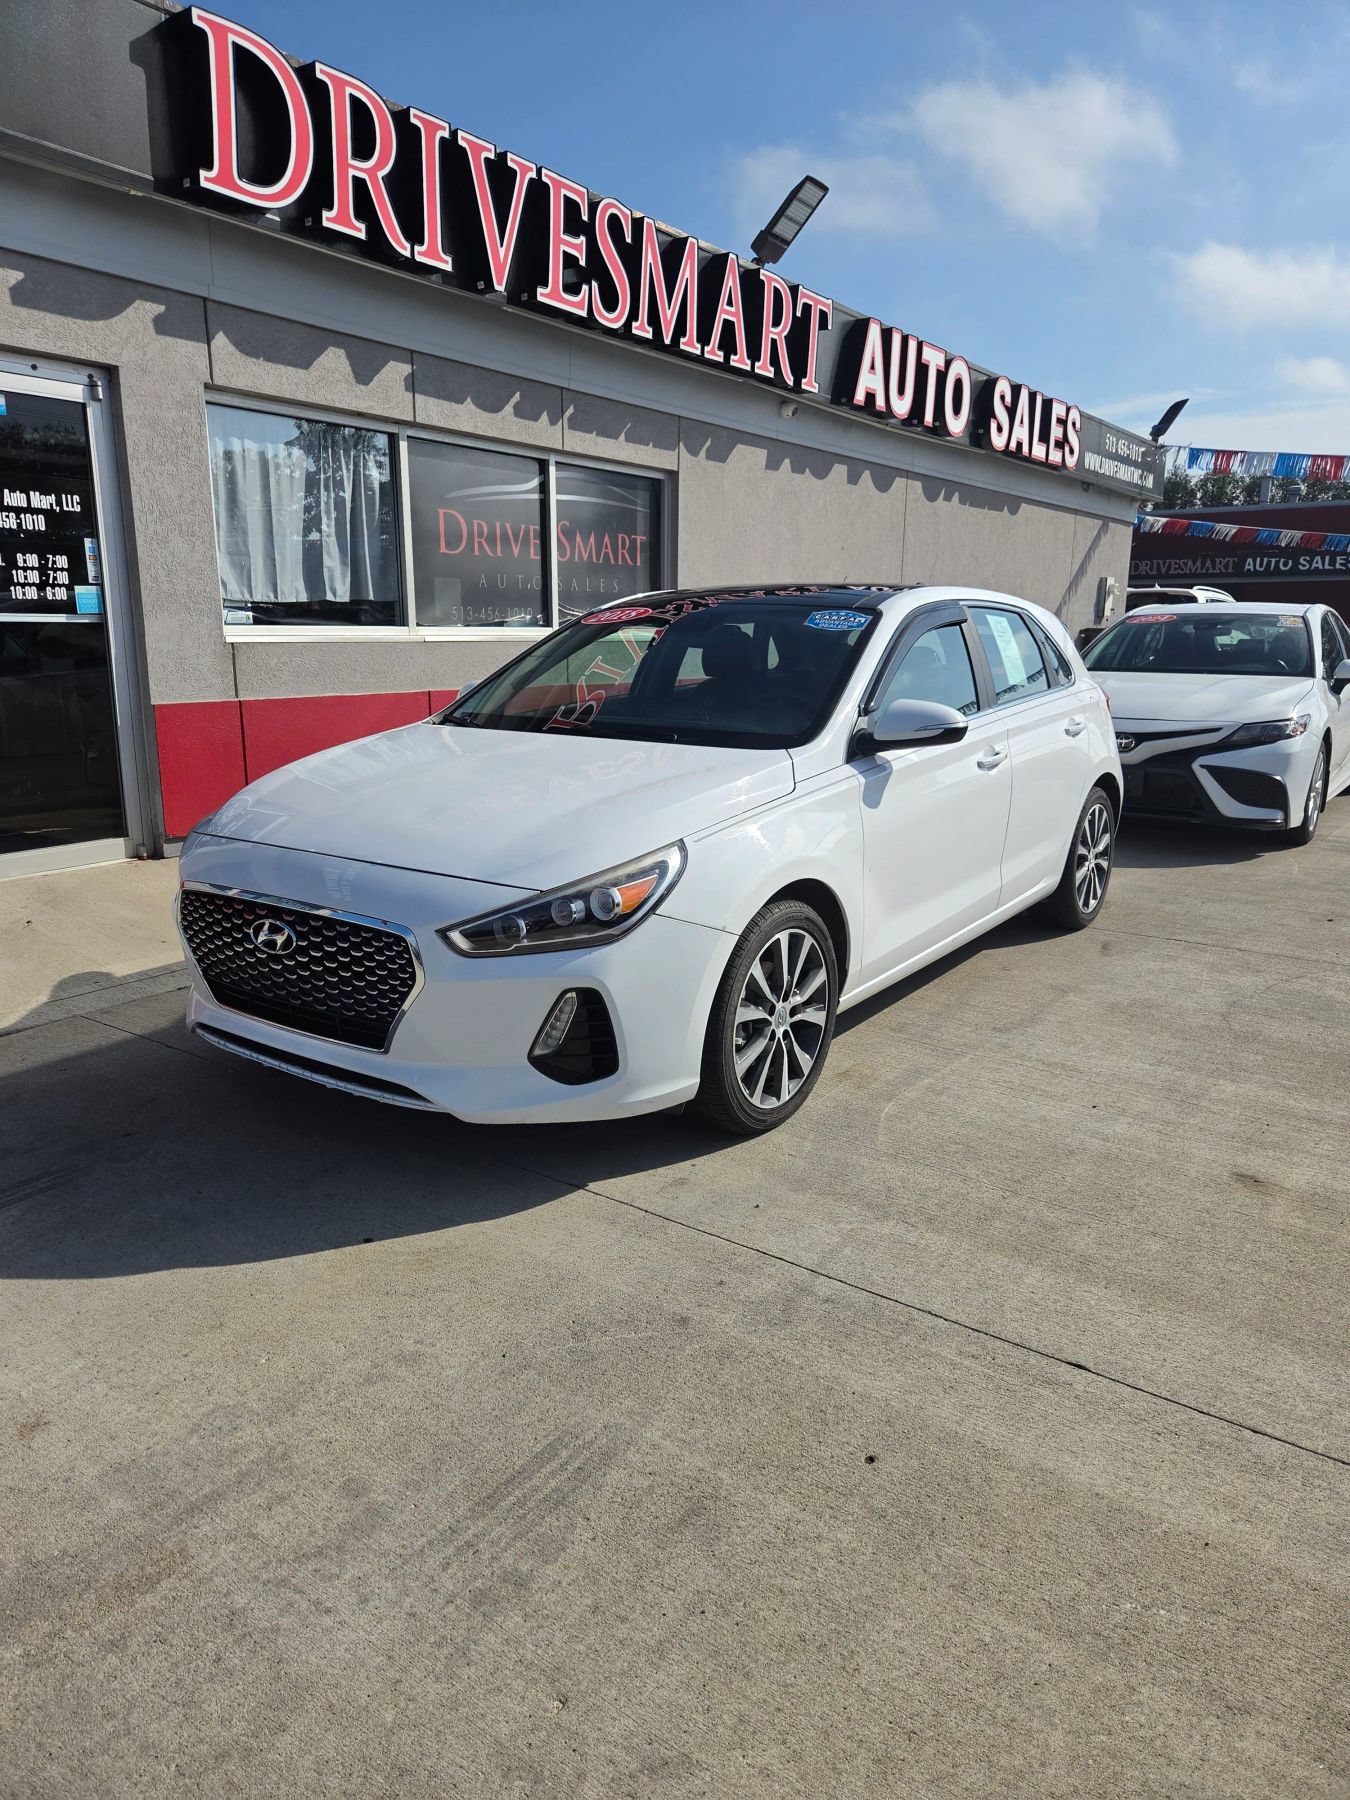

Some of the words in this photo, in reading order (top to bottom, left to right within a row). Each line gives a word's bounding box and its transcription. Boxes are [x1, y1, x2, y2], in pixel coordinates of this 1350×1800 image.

[191, 5, 832, 393] DRIVESMART
[853, 317, 972, 438] AUTO
[990, 375, 1082, 471] SALES
[3, 488, 27, 508] Auto
[29, 490, 60, 513] Mart,
[61, 493, 81, 512] LLC
[16, 553, 39, 568] 9:00
[46, 554, 68, 568] 7:00
[1130, 557, 1238, 576] DRIVESMART
[1244, 557, 1293, 572] AUTO
[11, 569, 40, 584] 10:00
[47, 570, 69, 584] 7:00
[478, 572, 542, 590] AUTO
[557, 575, 619, 593] SALES
[9, 585, 38, 600] 10:00
[46, 586, 67, 600] 6:00
